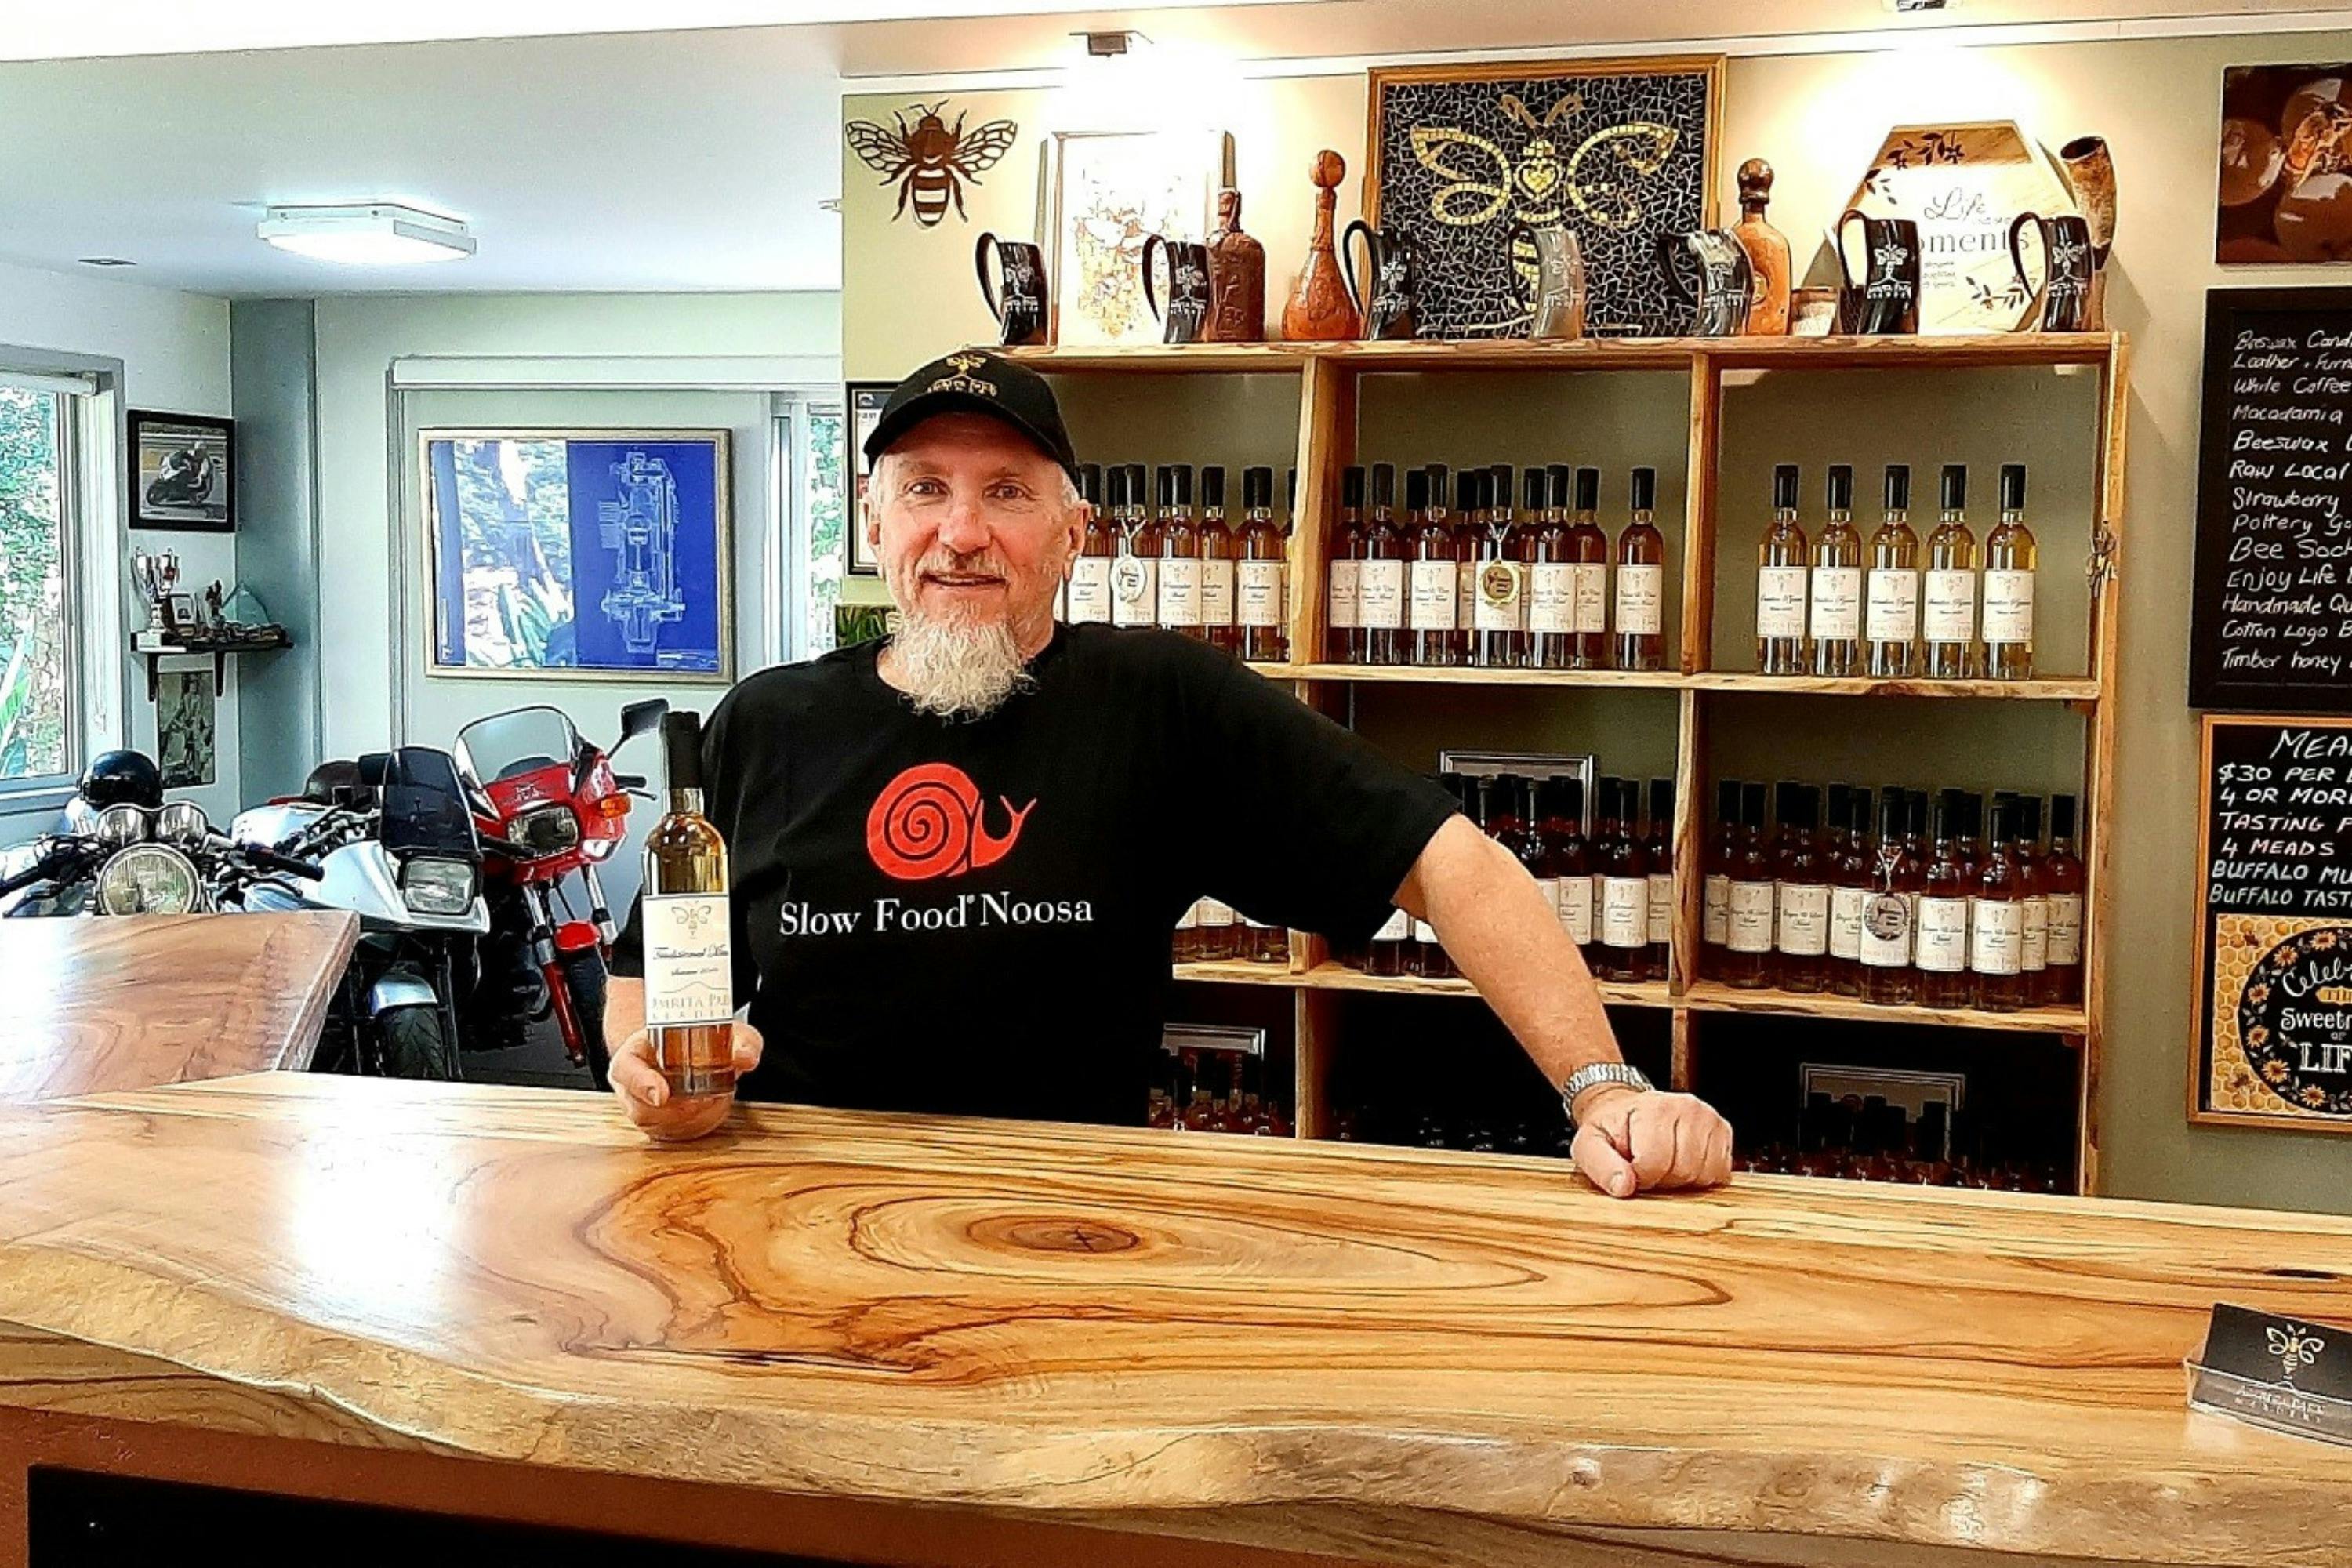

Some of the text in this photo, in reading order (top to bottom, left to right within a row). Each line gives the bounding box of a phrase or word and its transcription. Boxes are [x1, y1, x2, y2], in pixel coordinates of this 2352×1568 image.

[1920, 228, 2029, 253] ments
[2307, 329, 2352, 348] Cand
[2293, 376, 2352, 394] Coffee
[2233, 403, 2343, 425] Macadamia
[2233, 430, 2328, 453] Beeswax
[2229, 459, 2350, 481] Raw Local
[2233, 513, 2313, 539] Pottery
[2229, 536, 2285, 562] Bee
[2226, 562, 2337, 593] Enjoy Life
[2222, 593, 2322, 615] Handmade
[2222, 619, 2276, 638] Cotton
[2283, 624, 2328, 647] Logo
[2222, 646, 2342, 677] Timber honey
[2269, 729, 2352, 760] MEA
[2217, 762, 2336, 785] $30 PER
[2220, 786, 2352, 808] 4 OR MOR
[2221, 837, 2335, 859] 4 MEADS
[2212, 859, 2310, 880] BUFFALO
[2303, 889, 2352, 908] TAST
[779, 902, 862, 935] Slow
[979, 891, 1095, 926] Noosa
[2282, 956, 2352, 997] Celeb
